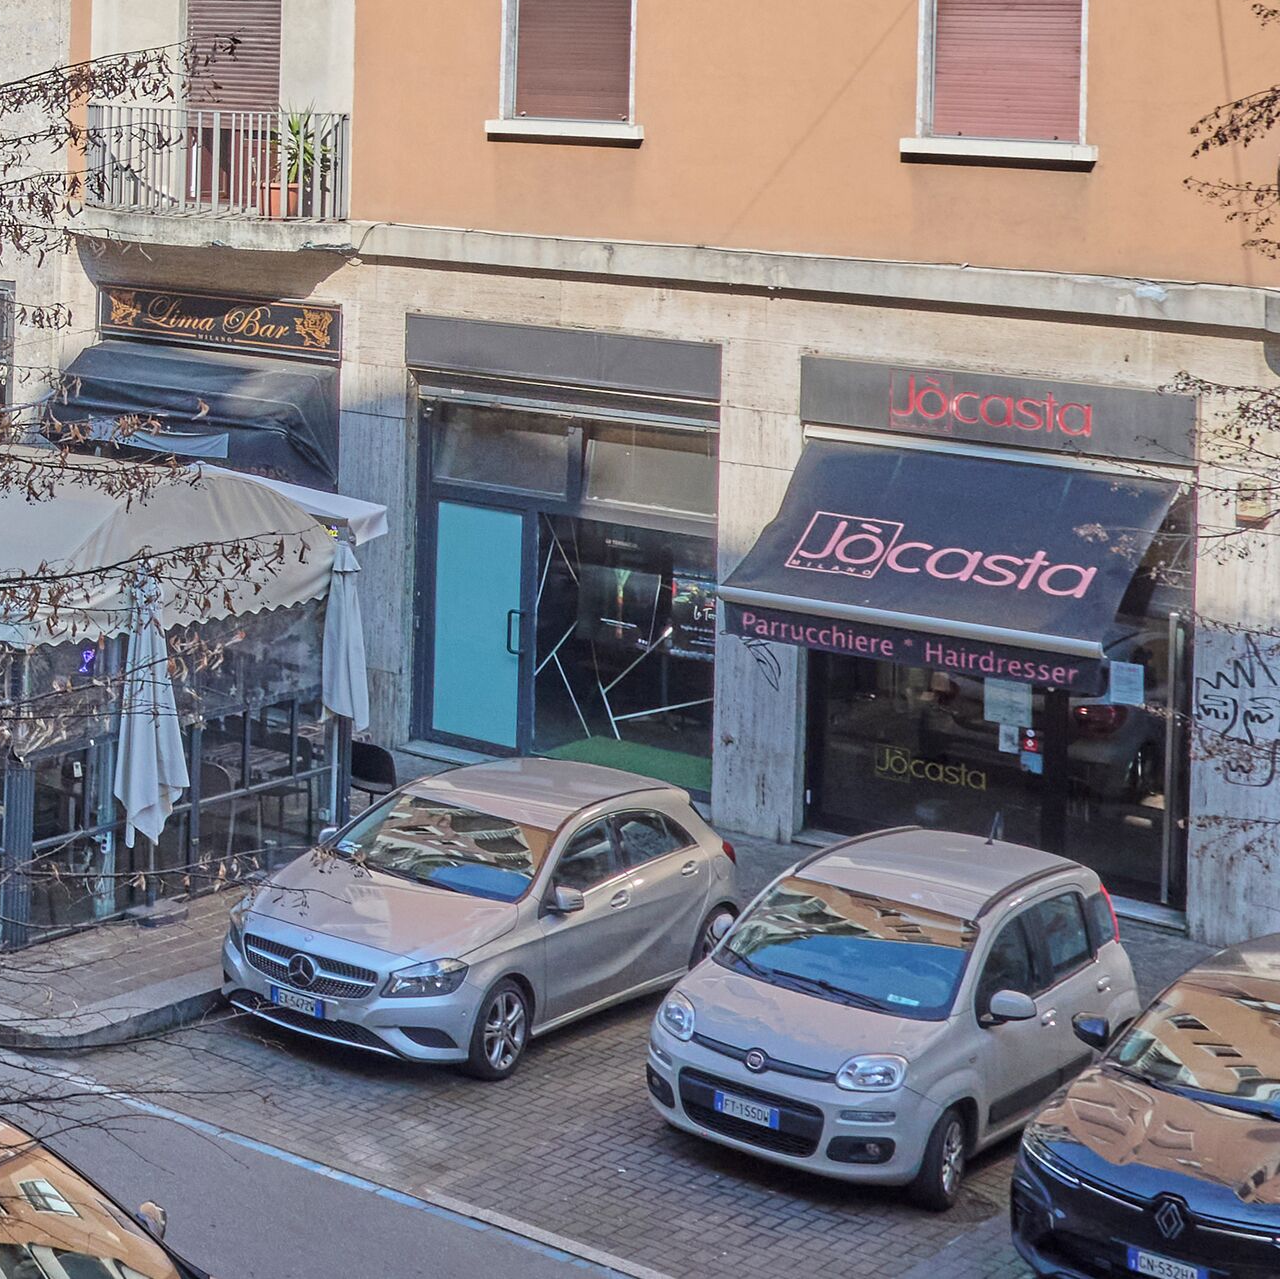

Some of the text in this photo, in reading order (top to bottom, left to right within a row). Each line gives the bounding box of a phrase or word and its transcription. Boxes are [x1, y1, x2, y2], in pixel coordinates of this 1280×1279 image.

[143, 295, 290, 340] Lima Bar
[197, 333, 233, 343] MILANO
[891, 373, 1093, 438] Jòcasta
[790, 559, 872, 576] MILANO
[798, 520, 1098, 599] Jòcasta
[741, 611, 894, 656] Parrucchiere
[925, 641, 1079, 685] Hairdresser
[876, 747, 987, 791] Jòcasta
